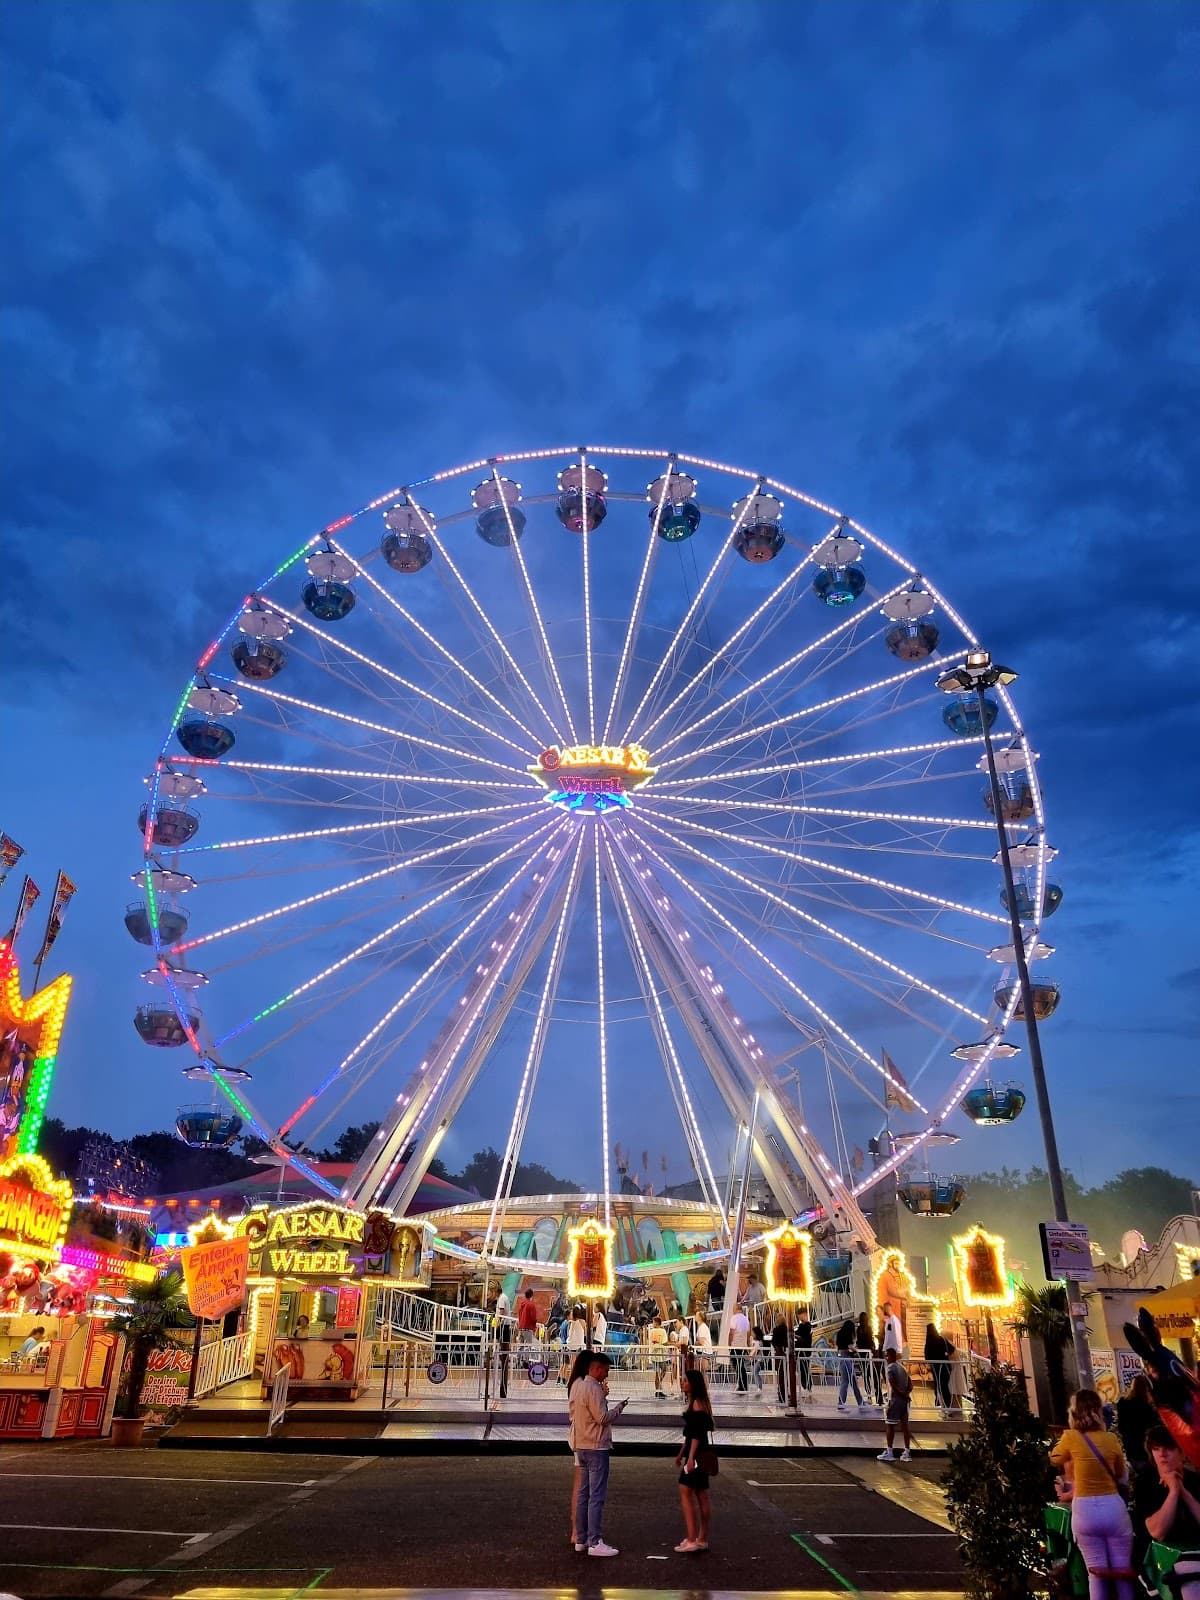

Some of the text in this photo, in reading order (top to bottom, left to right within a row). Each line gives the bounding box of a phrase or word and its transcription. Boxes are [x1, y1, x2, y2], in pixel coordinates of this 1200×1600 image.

[538, 745, 650, 771] CAESAR'S
[237, 1209, 396, 1254] CAESAR'S
[189, 1247, 234, 1268] Enten-
[195, 1253, 243, 1281] Angeln
[269, 1249, 355, 1274] WHEEL
